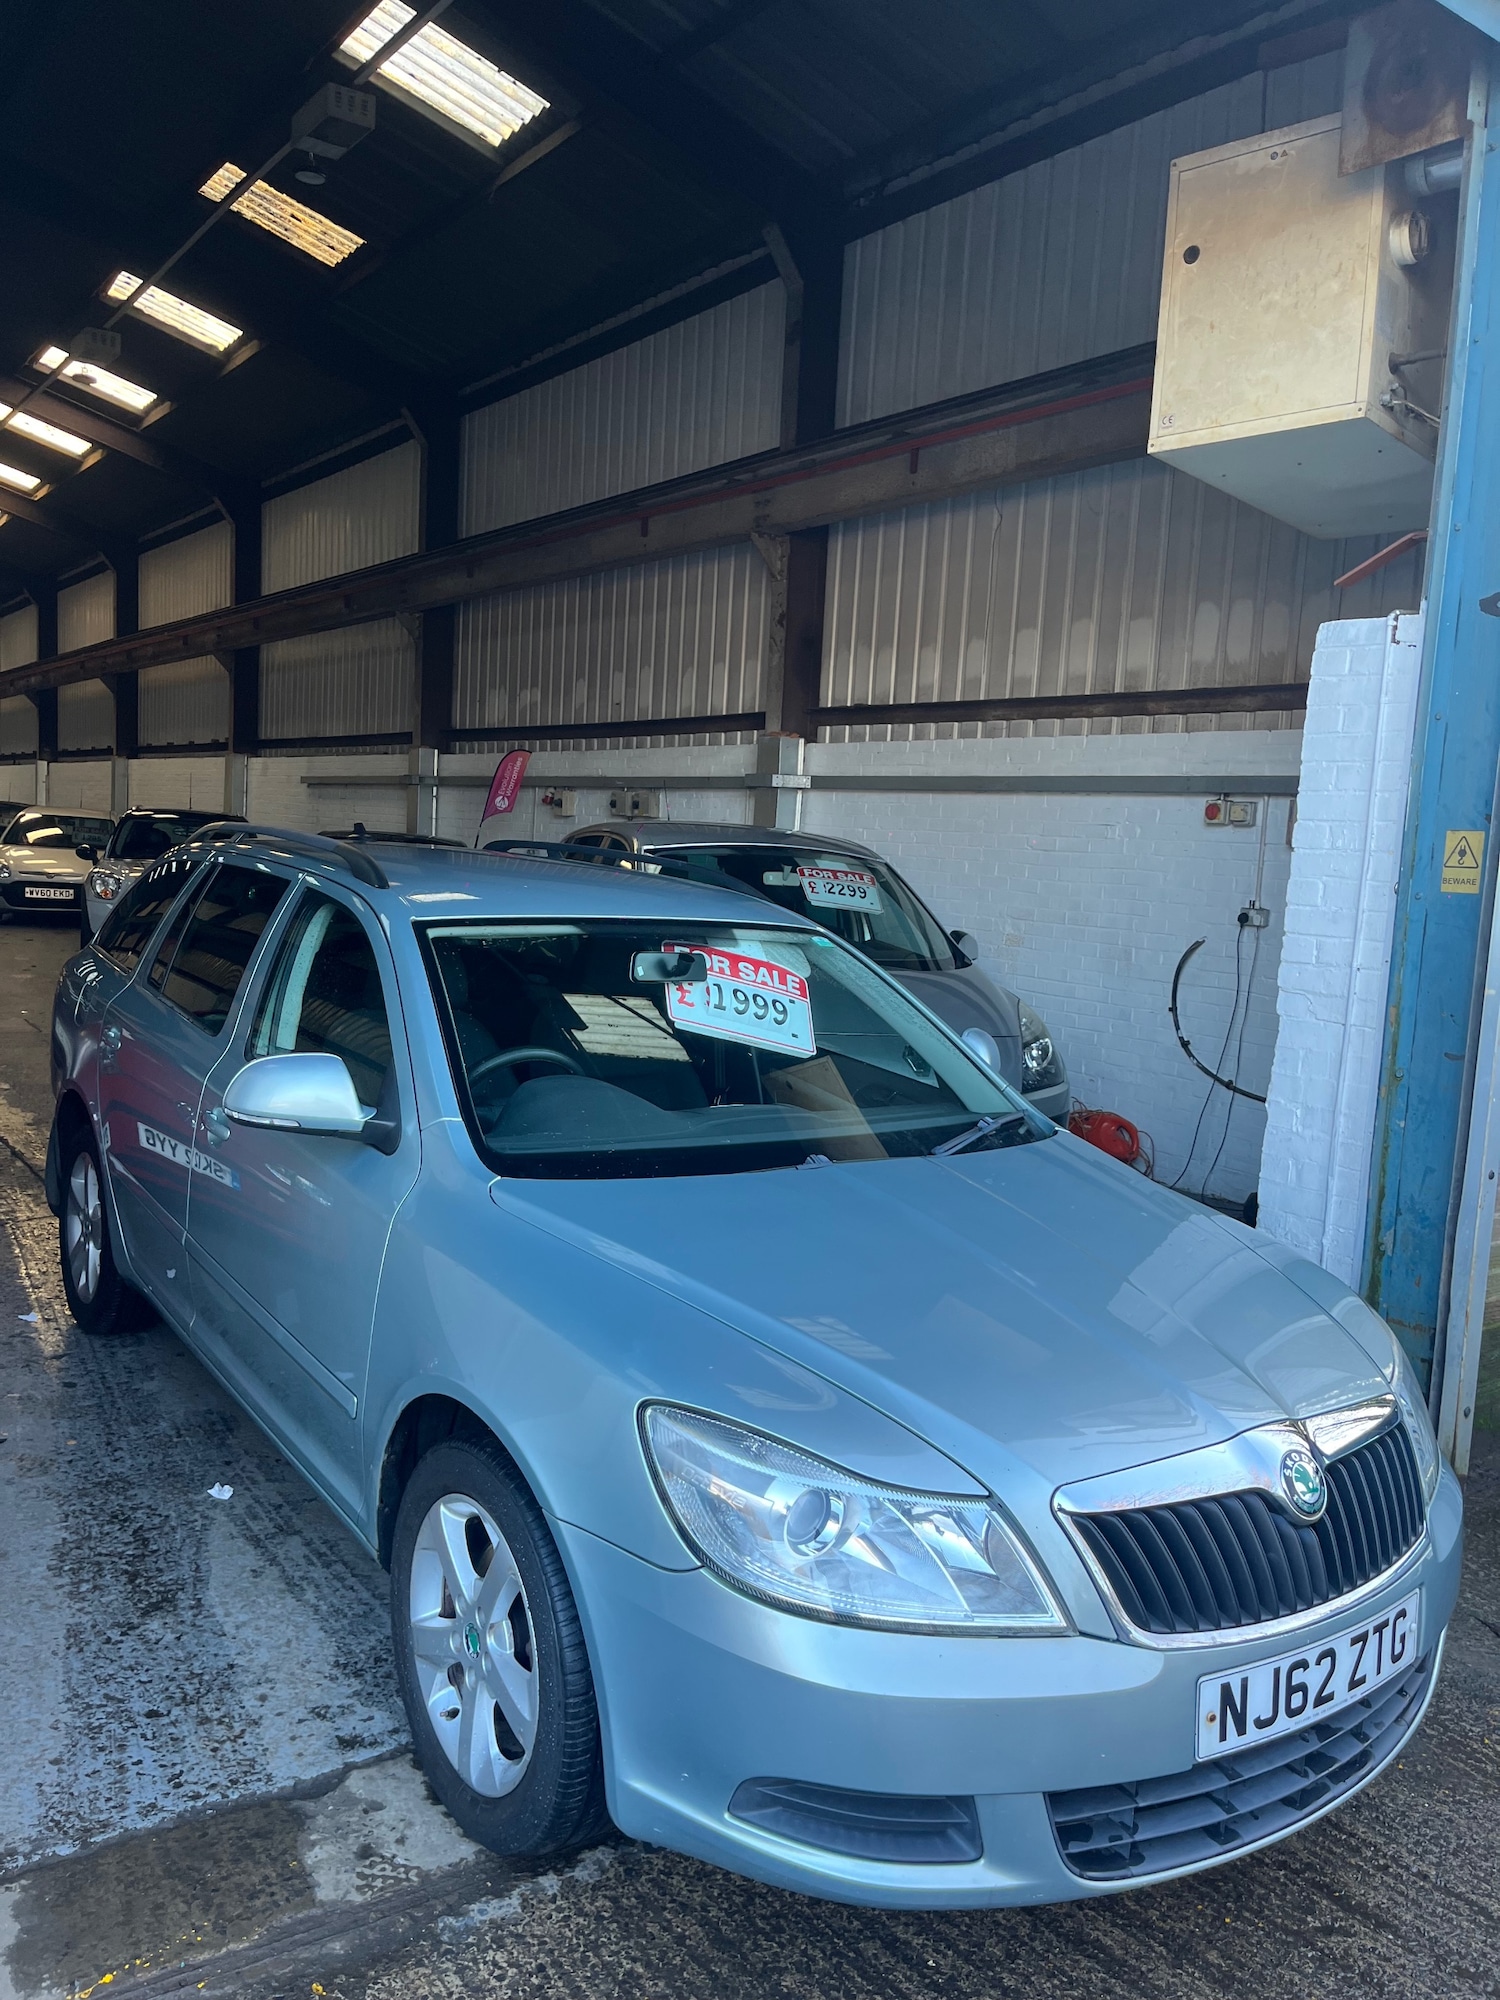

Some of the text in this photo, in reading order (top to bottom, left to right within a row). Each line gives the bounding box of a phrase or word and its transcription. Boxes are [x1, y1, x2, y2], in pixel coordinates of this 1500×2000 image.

[498, 762, 513, 795] Evolution
[506, 757, 523, 797] Warranties
[29, 889, 51, 897] WV60
[802, 868, 872, 885] FOR SALE
[1442, 877, 1478, 886] BEWARE
[738, 961, 802, 995] SALE
[712, 983, 788, 1025] 1999
[1219, 1608, 1407, 1743] NJ62 ZTG
